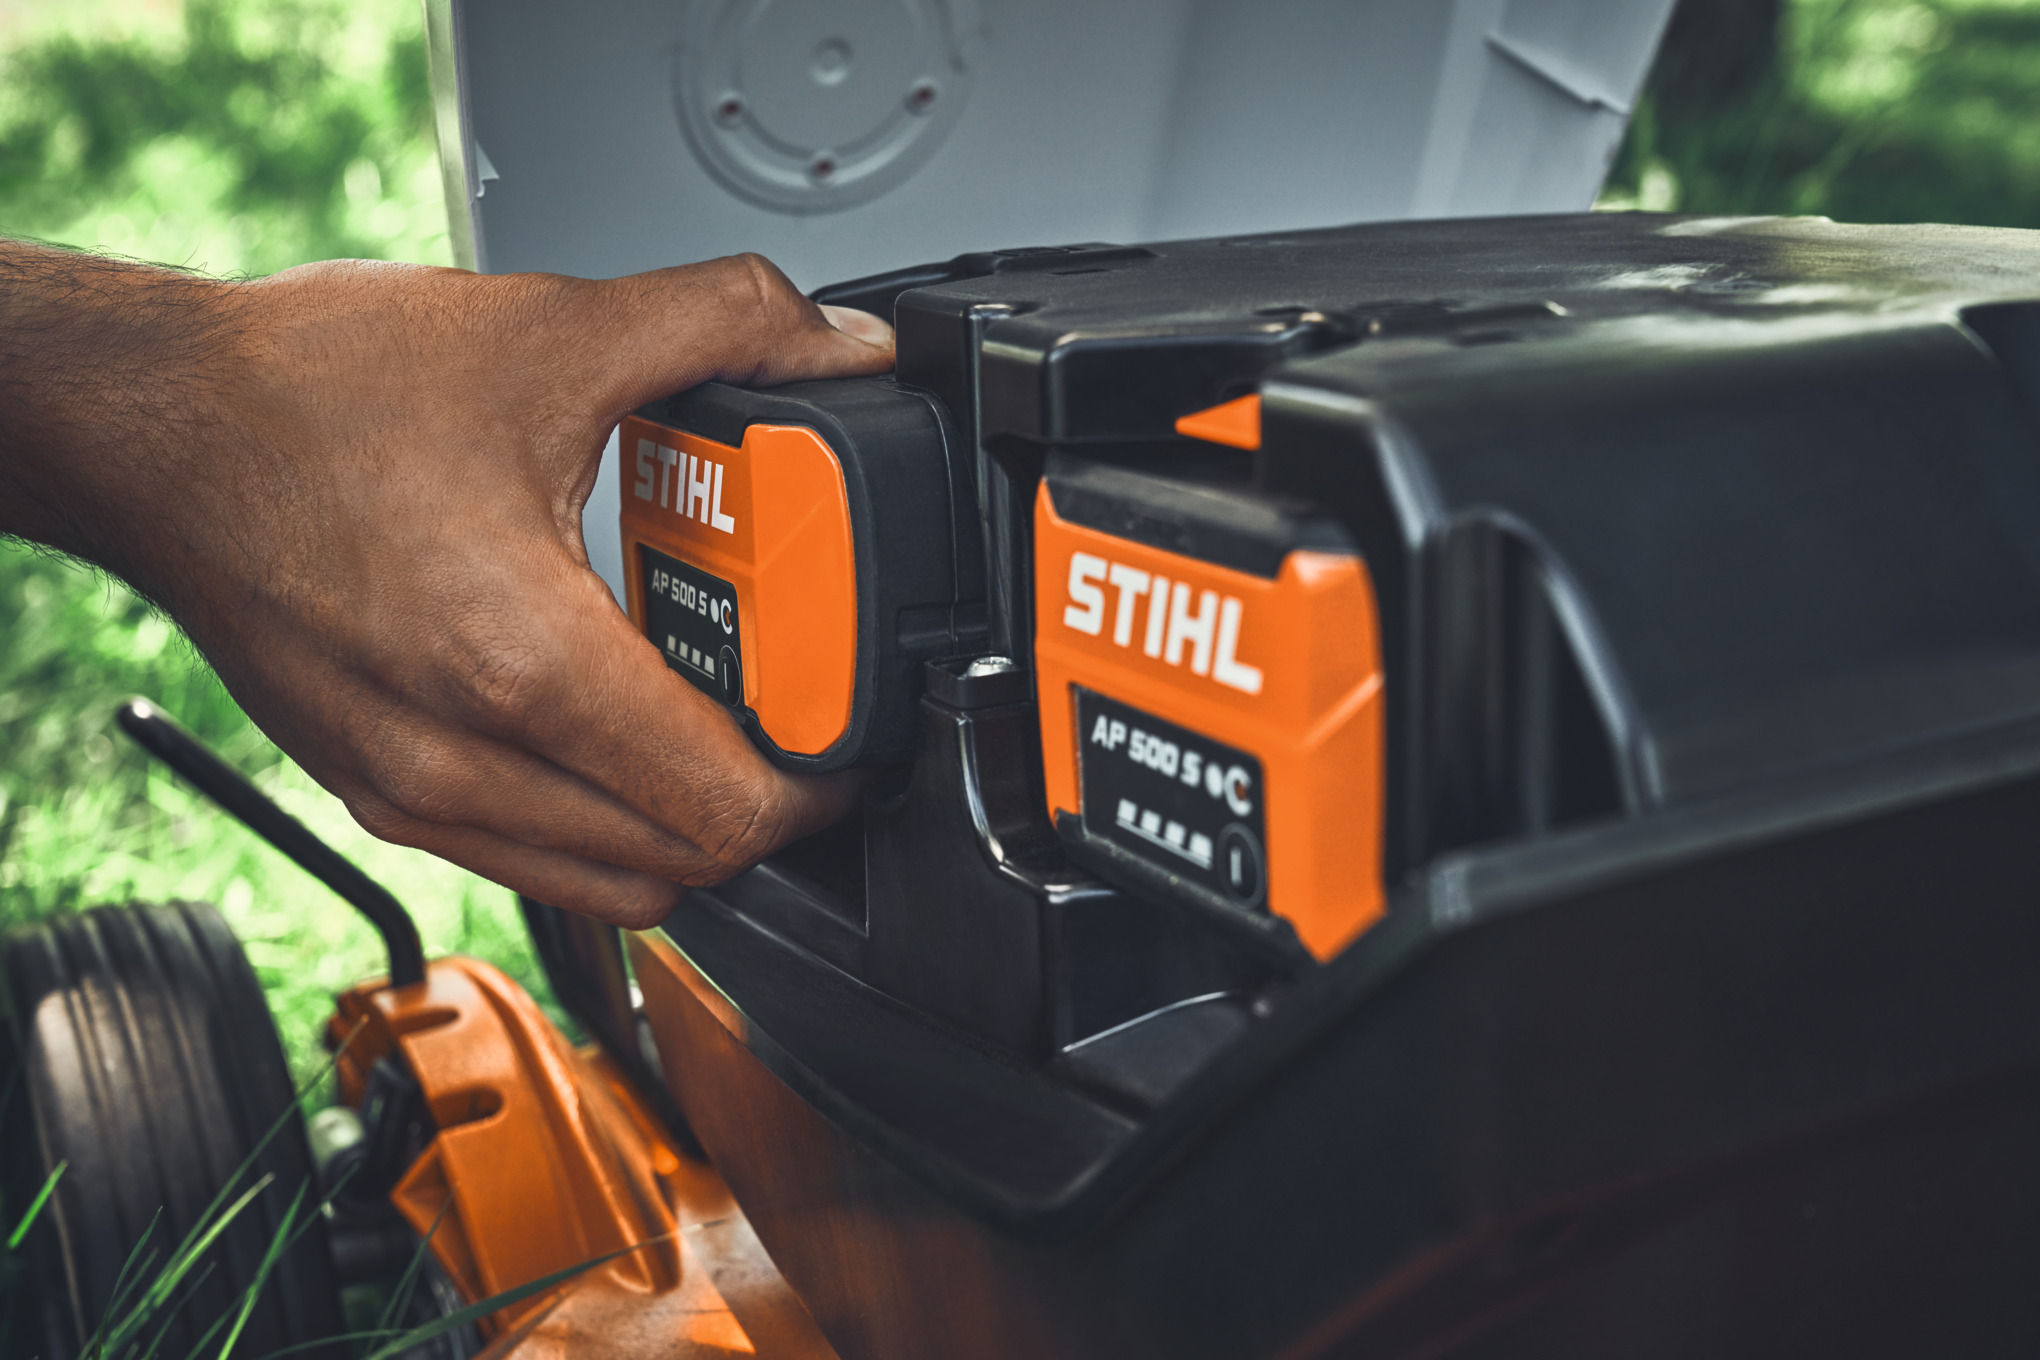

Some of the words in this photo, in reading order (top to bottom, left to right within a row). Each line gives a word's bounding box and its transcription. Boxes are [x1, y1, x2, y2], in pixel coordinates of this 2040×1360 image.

[635, 438, 735, 535] STIHL
[652, 568, 669, 595] AP
[671, 577, 696, 611] 500
[698, 590, 708, 616] S
[1064, 551, 1264, 696] STIHL
[1091, 714, 1127, 751] AP
[1128, 728, 1180, 778] 500
[1180, 749, 1202, 789] S
